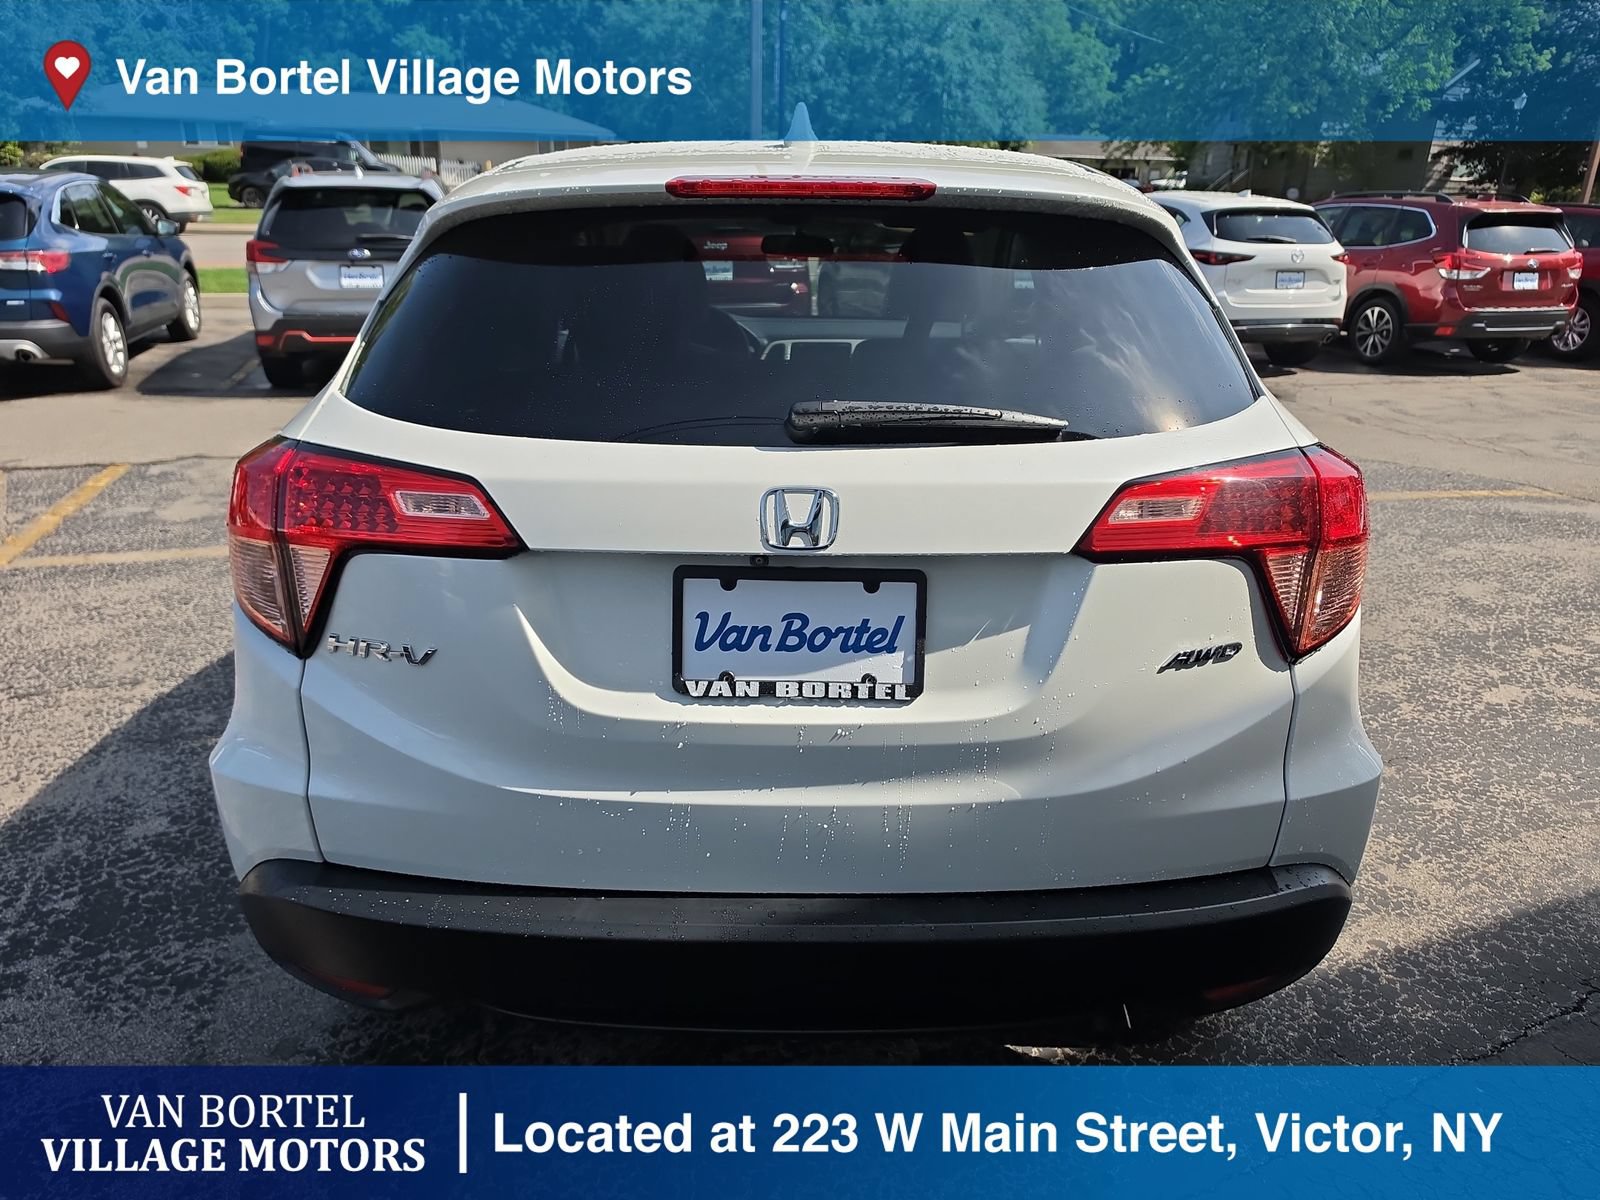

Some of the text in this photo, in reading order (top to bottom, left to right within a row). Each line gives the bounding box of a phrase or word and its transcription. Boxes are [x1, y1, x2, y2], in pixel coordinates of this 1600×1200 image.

[327, 632, 438, 666] HR-V
[694, 611, 906, 654] Van Bortel
[1156, 641, 1243, 675] AWD
[684, 680, 911, 700] VAN BORTEL
